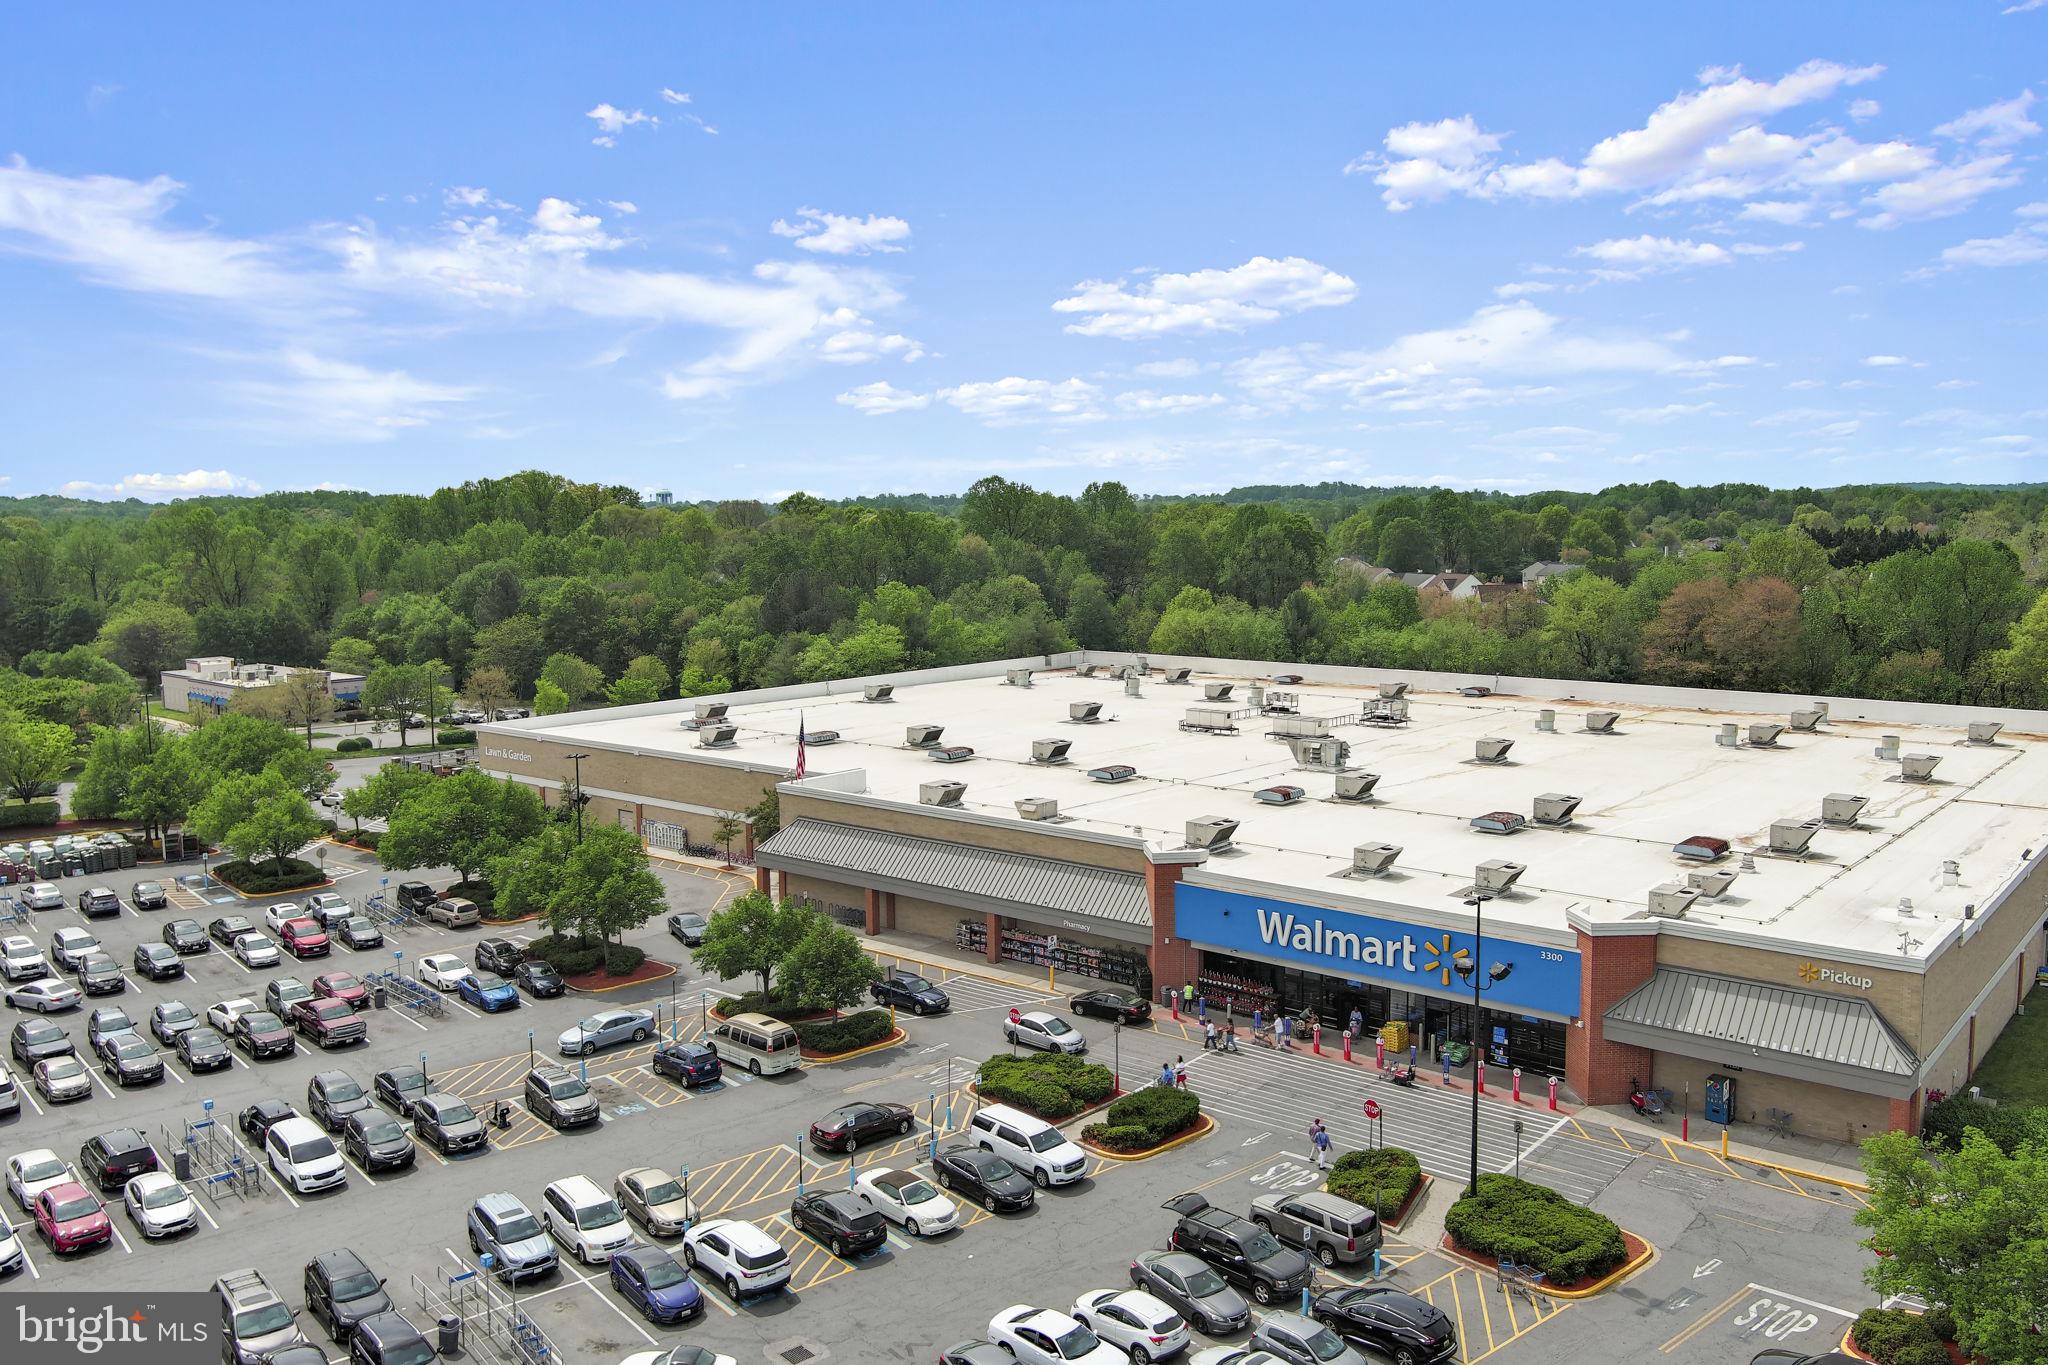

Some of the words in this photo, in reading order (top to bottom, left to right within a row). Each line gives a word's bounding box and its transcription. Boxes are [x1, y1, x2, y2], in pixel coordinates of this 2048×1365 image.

[485, 746, 502, 758] Lawn
[502, 748, 508, 759] &
[508, 749, 532, 762] Garden
[1063, 920, 1091, 933] Pharmacy
[1256, 908, 1417, 972] Walmart
[1540, 950, 1563, 962] 3300
[1821, 968, 1873, 990] Pickup
[1364, 1103, 1379, 1115] STOP
[1249, 1161, 1320, 1190] STOP
[1733, 1298, 1819, 1341] STOP
